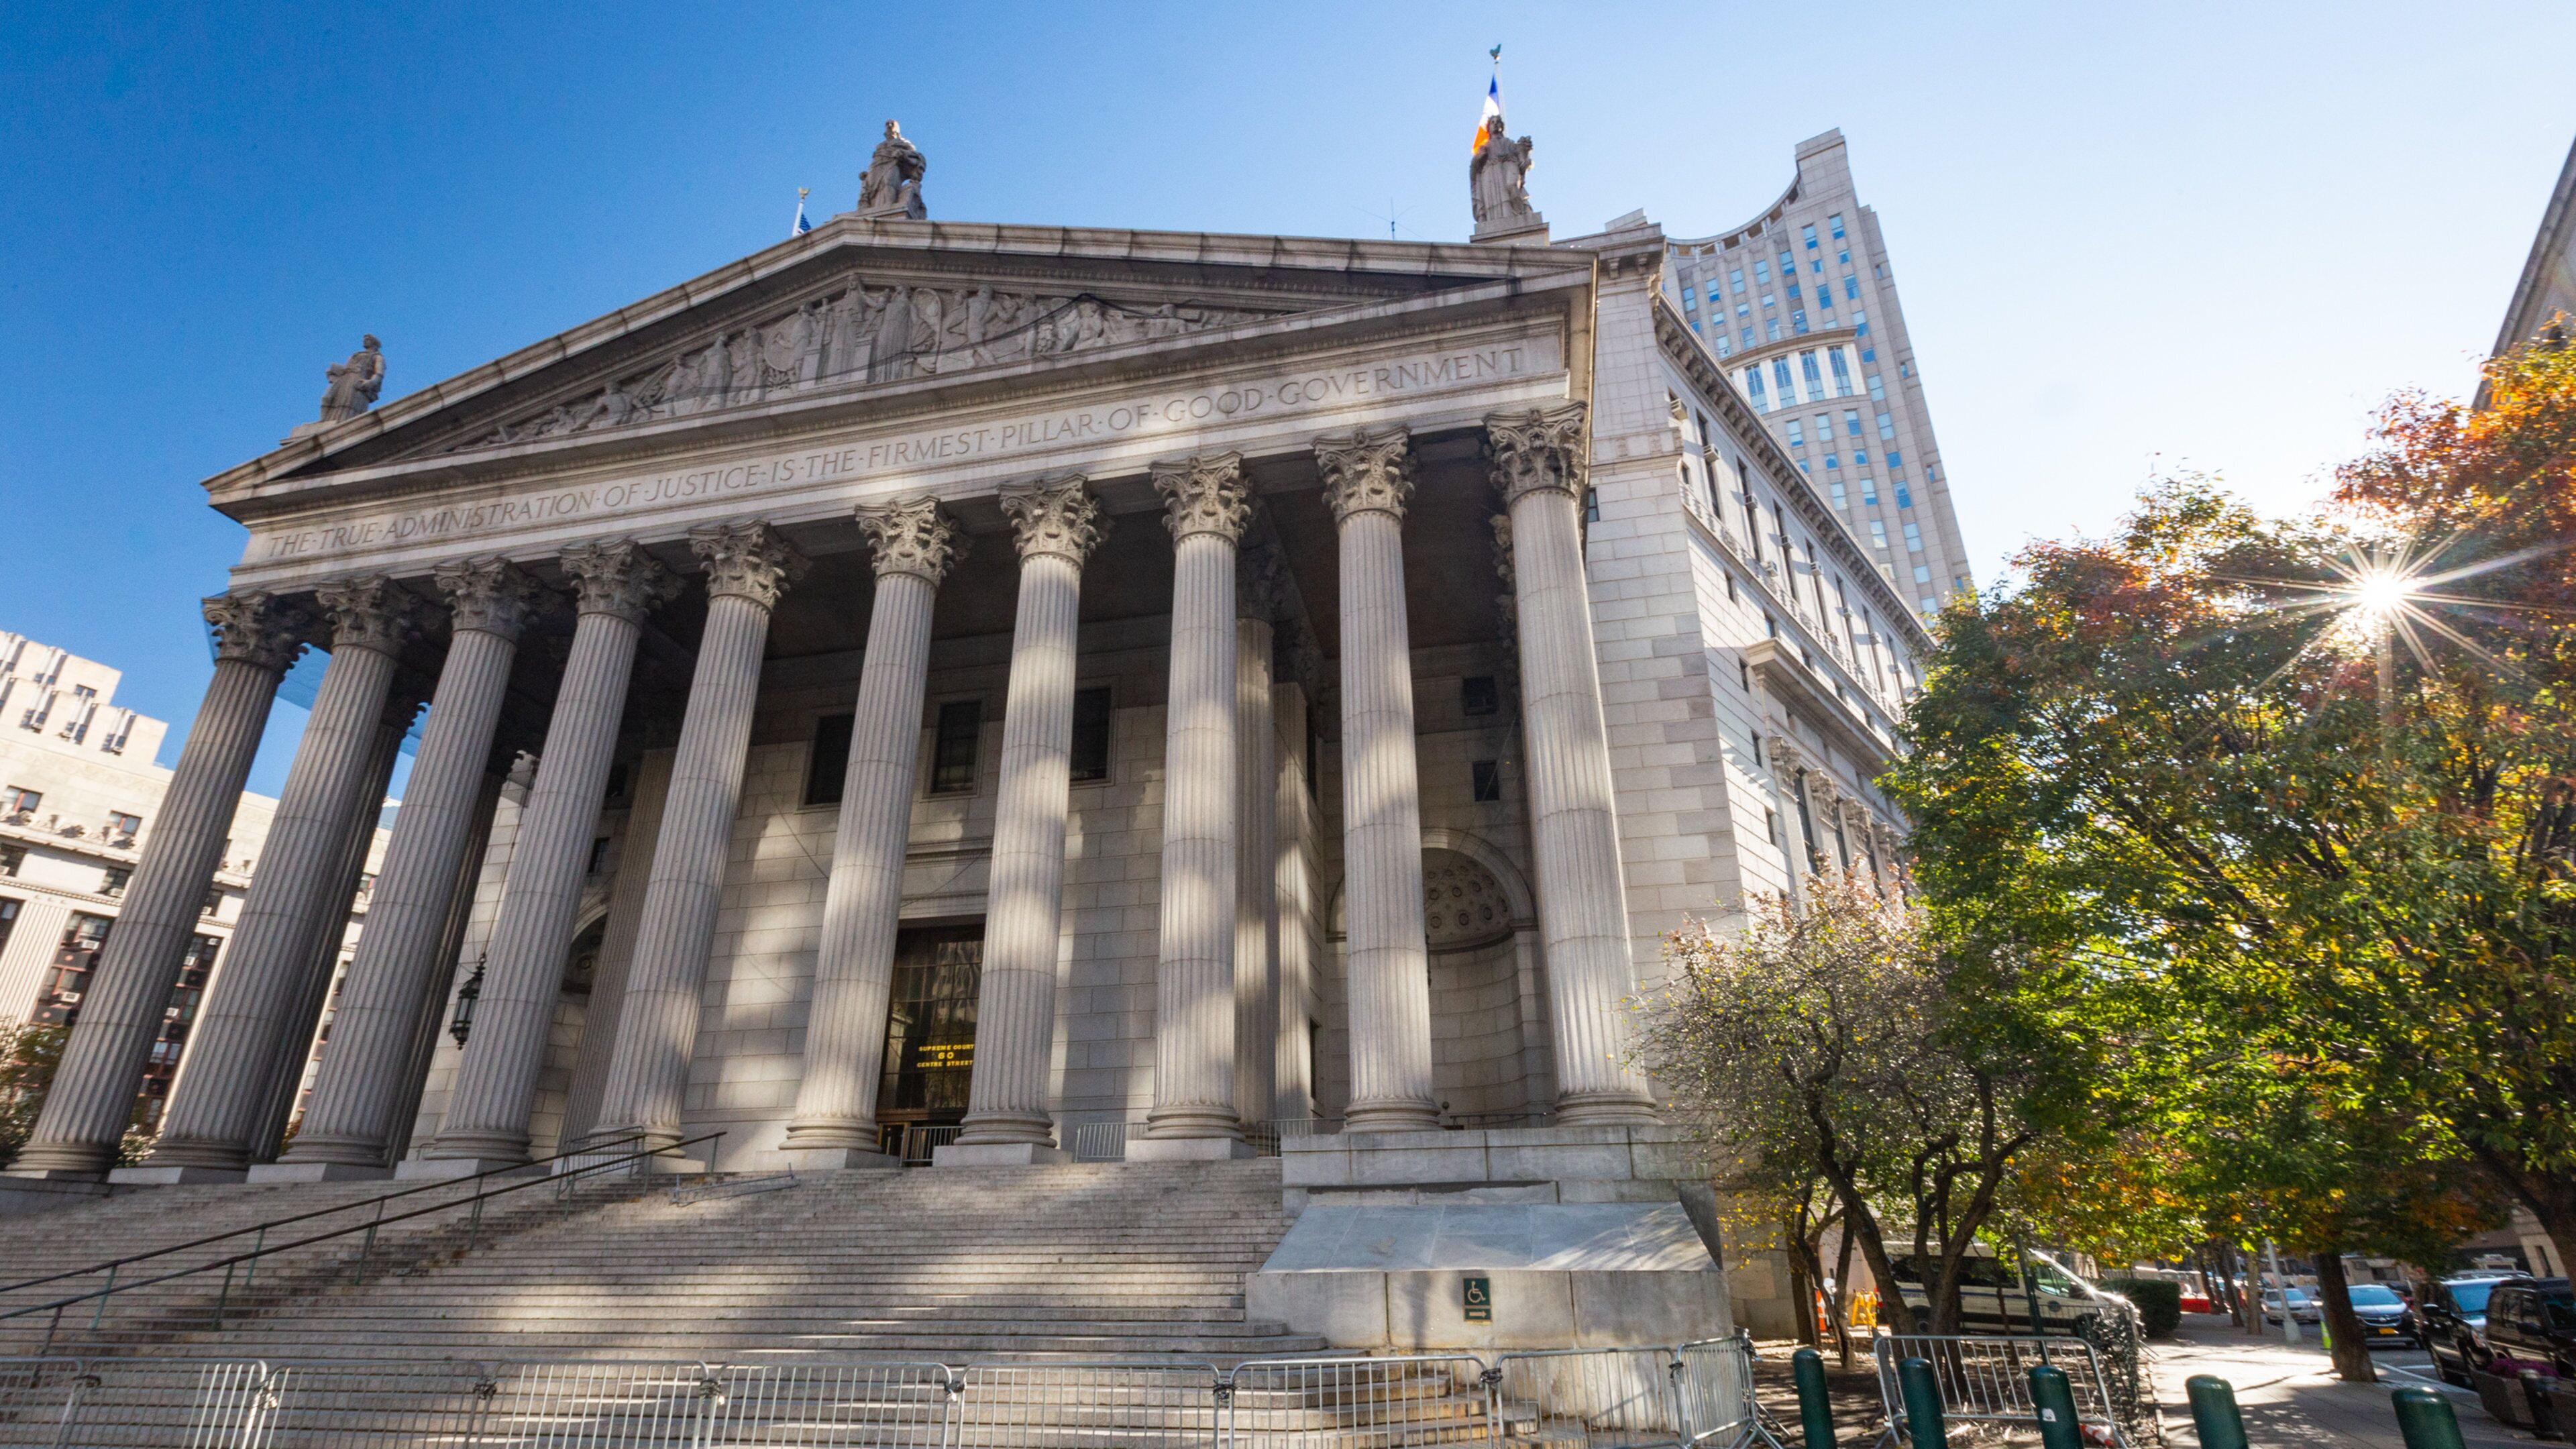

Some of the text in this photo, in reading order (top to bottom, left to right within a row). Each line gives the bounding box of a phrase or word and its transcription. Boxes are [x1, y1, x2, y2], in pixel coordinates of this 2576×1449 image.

[270, 347, 1521, 557] THE TRUE ADMINISTRATION OF JUSTICE IS THE FIRMEST PILLAR OF GOOD GOVERNMENT
[938, 1051, 954, 1059] 60
